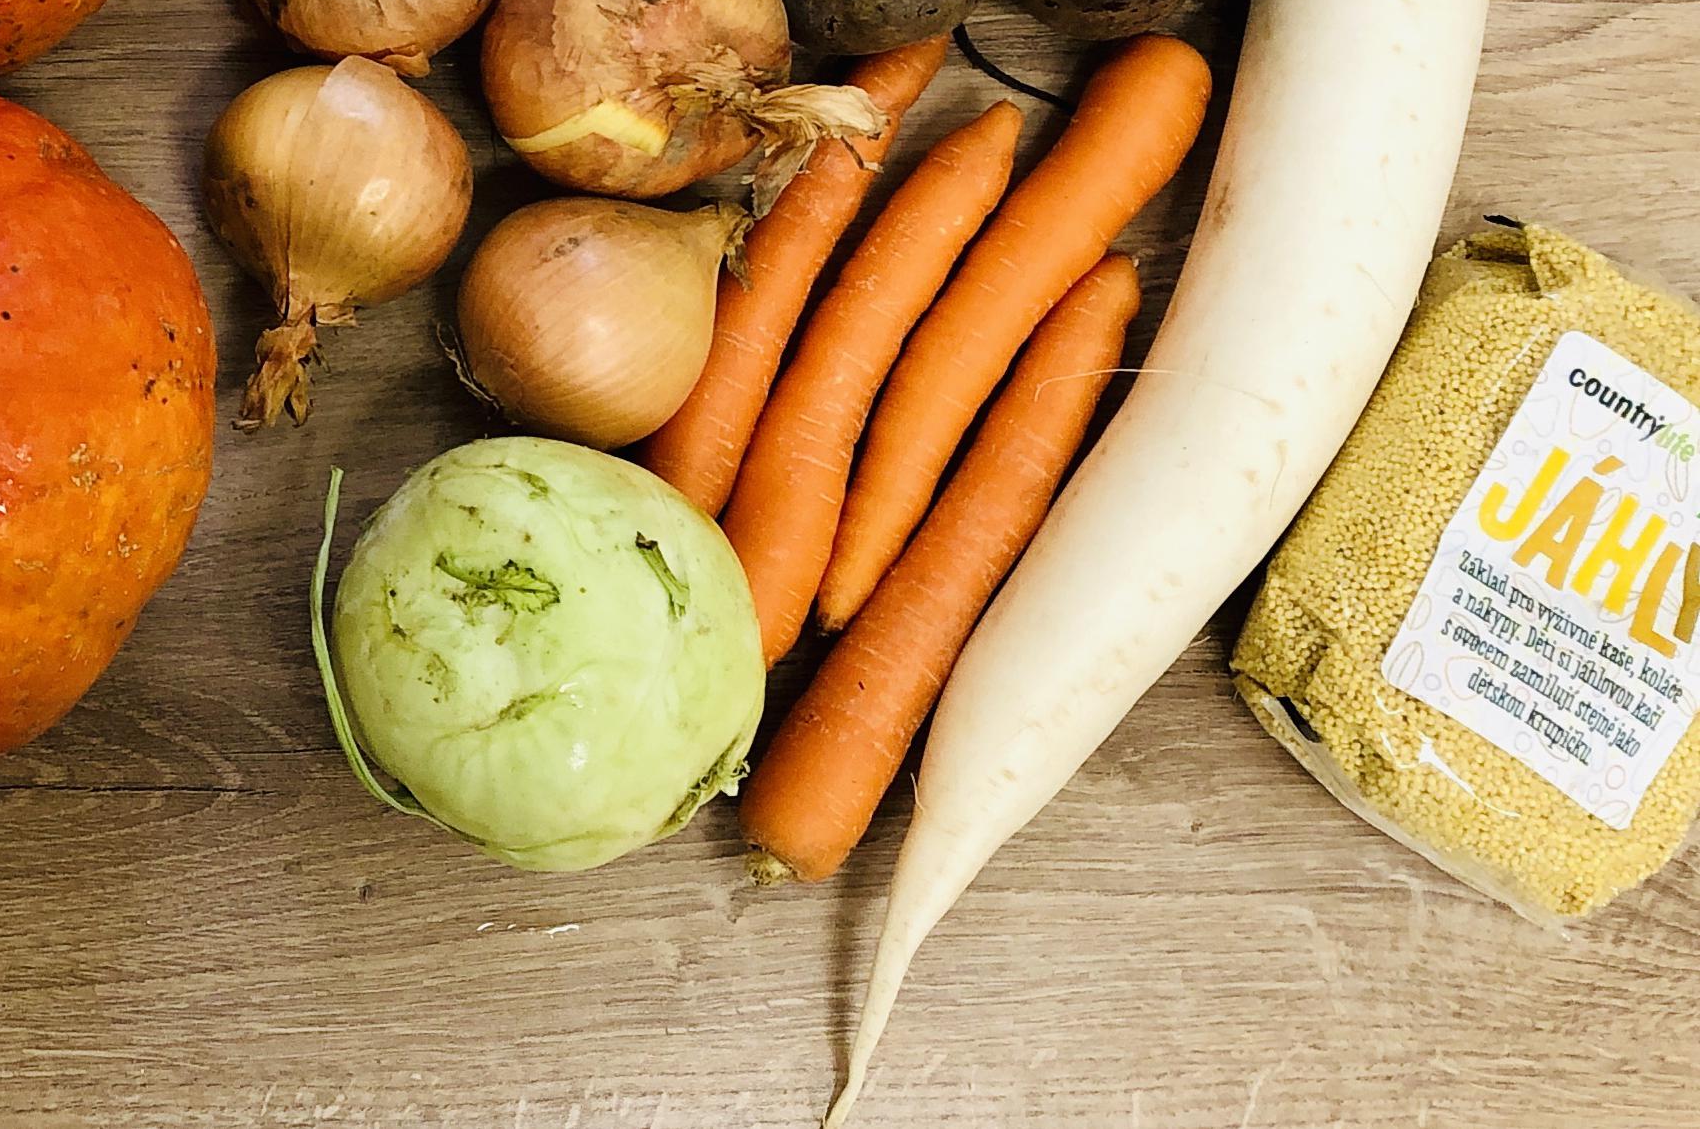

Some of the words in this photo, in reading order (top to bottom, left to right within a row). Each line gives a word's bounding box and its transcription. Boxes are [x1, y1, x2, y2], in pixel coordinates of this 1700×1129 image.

[1441, 619, 1453, 635] s
[1453, 626, 1509, 670] ovocem
[1510, 659, 1580, 713] zamilují
[1575, 700, 1618, 739] stejně
[1608, 721, 1641, 758] jako
[1452, 587, 1464, 605] a
[1524, 625, 1557, 662] Děti
[1557, 649, 1576, 672] si
[1571, 656, 1634, 711] jáhlovou
[1632, 693, 1665, 731] kaši
[1458, 550, 1509, 597] Základ
[1507, 586, 1535, 613] pro
[1538, 603, 1599, 650] výživné
[1599, 634, 1635, 677] kaše,
[1638, 657, 1683, 704] koláče
[1468, 667, 1525, 720] dětskou
